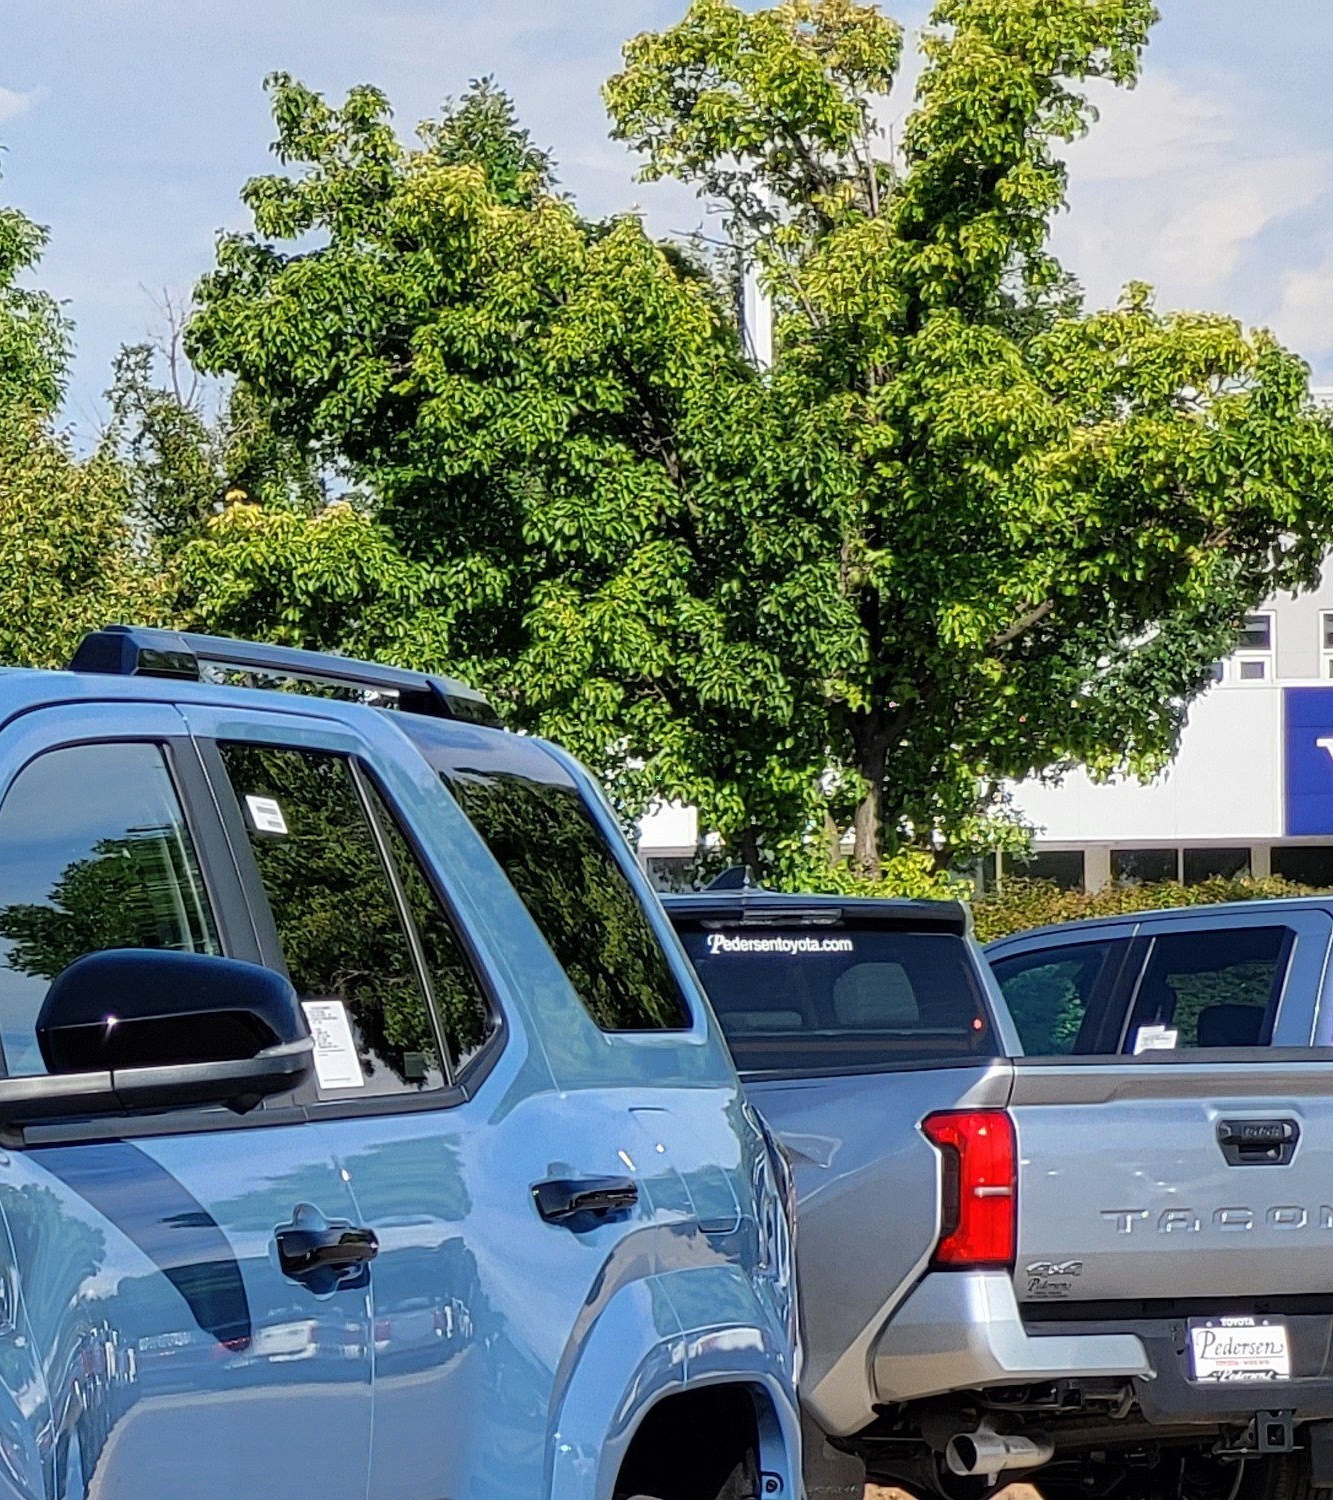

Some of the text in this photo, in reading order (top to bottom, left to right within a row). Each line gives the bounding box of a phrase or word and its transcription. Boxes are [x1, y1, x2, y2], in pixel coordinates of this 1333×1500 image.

[707, 934, 853, 955] Pedersentoyota.com
[1099, 1205, 1333, 1234] TACO
[1220, 1317, 1255, 1327] TOYOTA
[1196, 1330, 1284, 1359] Pedersen
